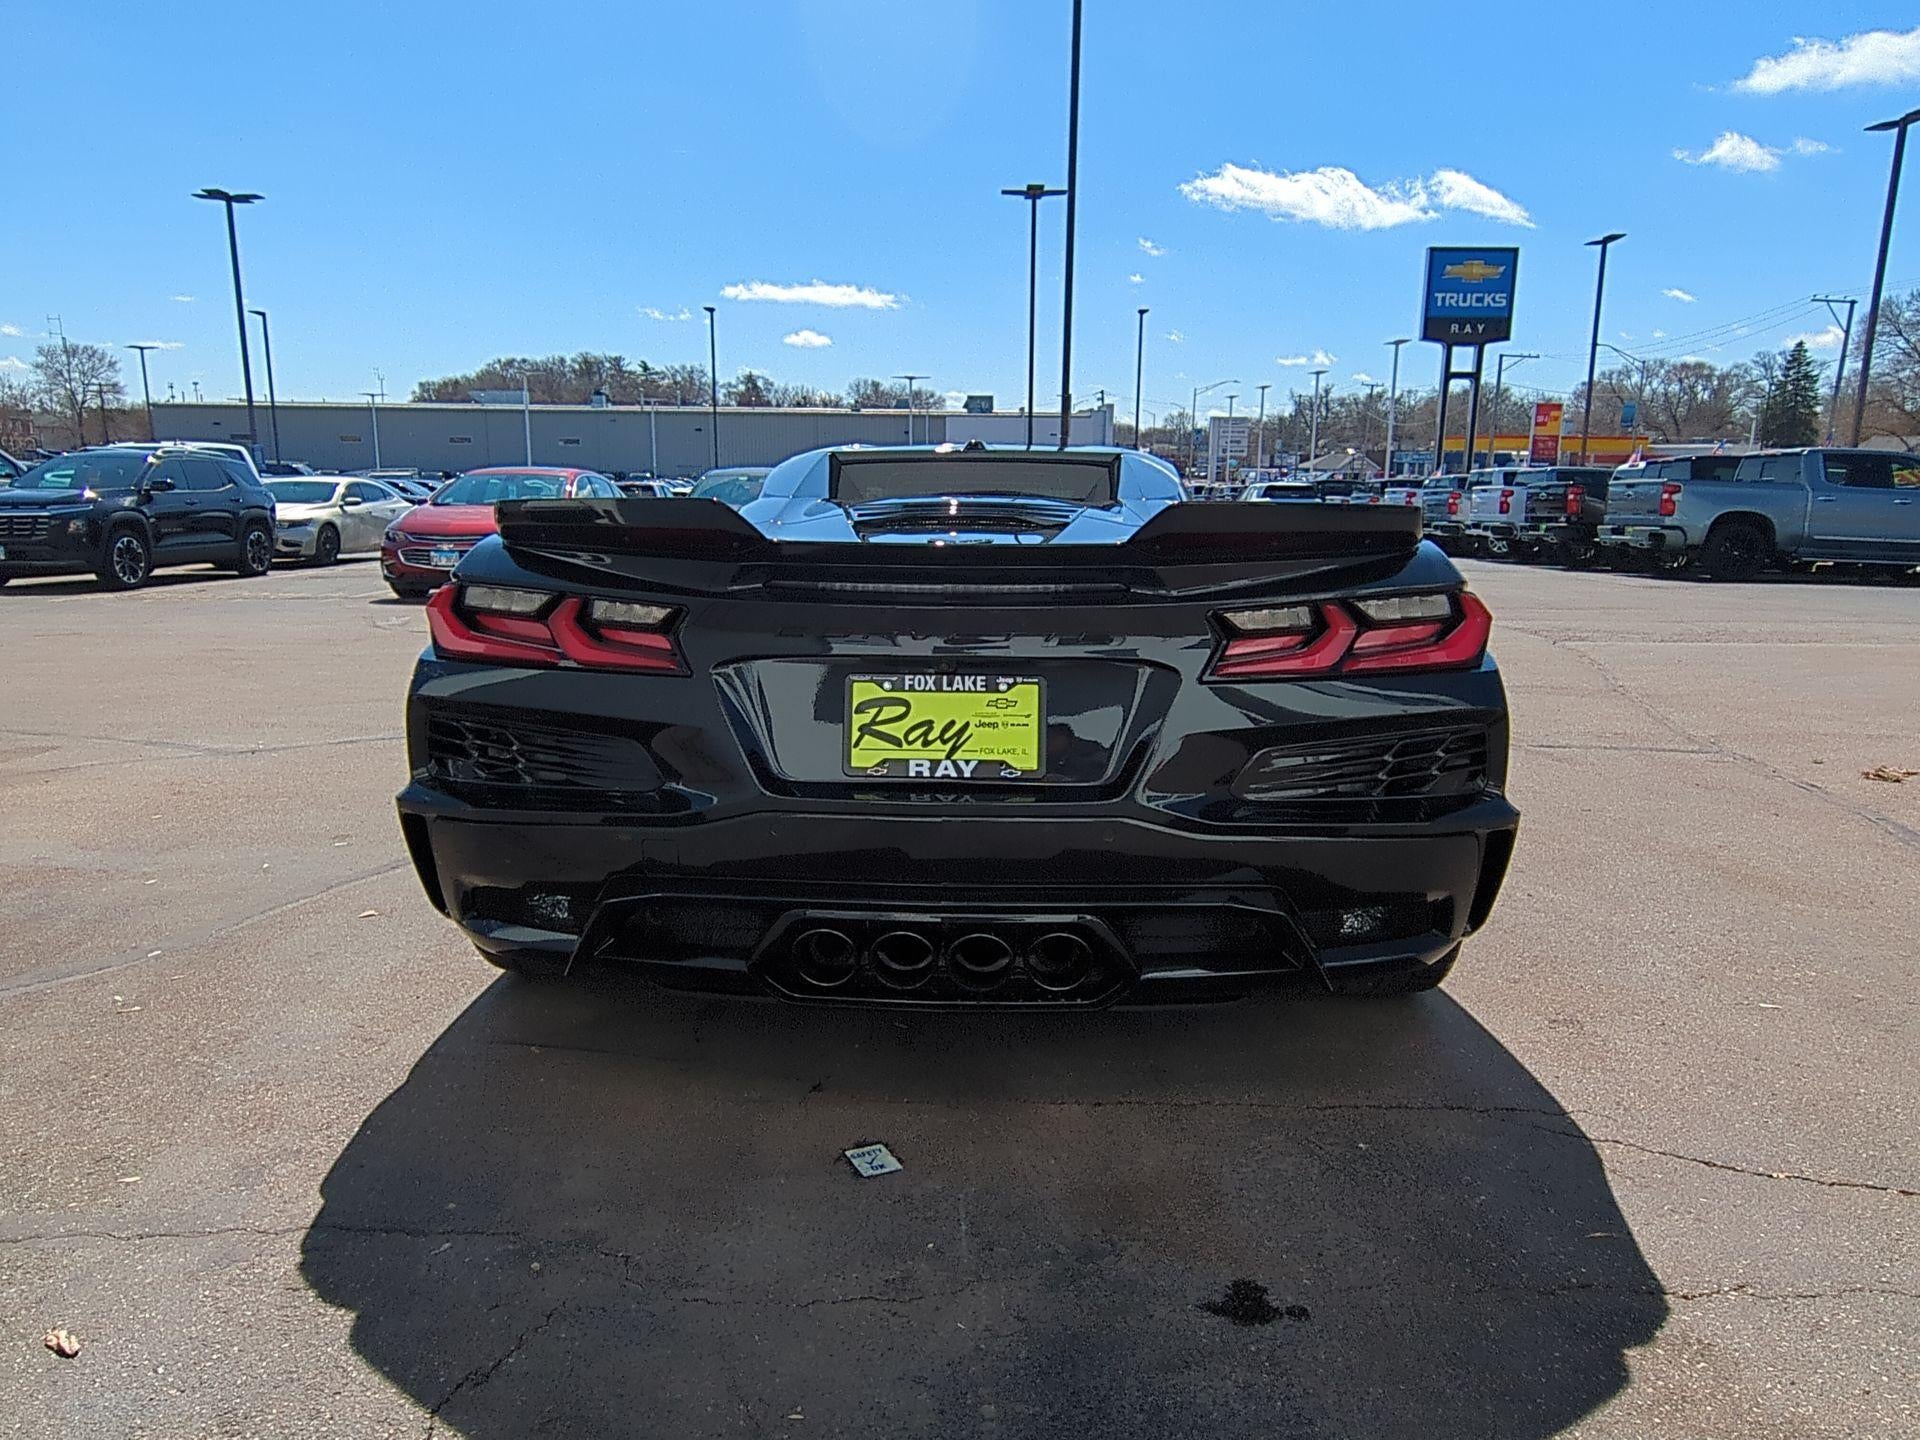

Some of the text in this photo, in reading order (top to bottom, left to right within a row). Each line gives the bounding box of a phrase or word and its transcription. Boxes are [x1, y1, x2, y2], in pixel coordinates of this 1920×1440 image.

[1434, 292, 1507, 308] TRUCKS
[1450, 323, 1485, 334] RAY
[904, 675, 987, 692] FOX LAKE
[853, 696, 974, 760] Ray
[975, 719, 999, 730] Jeep
[979, 747, 995, 755] FOX
[908, 760, 979, 778] RAY
